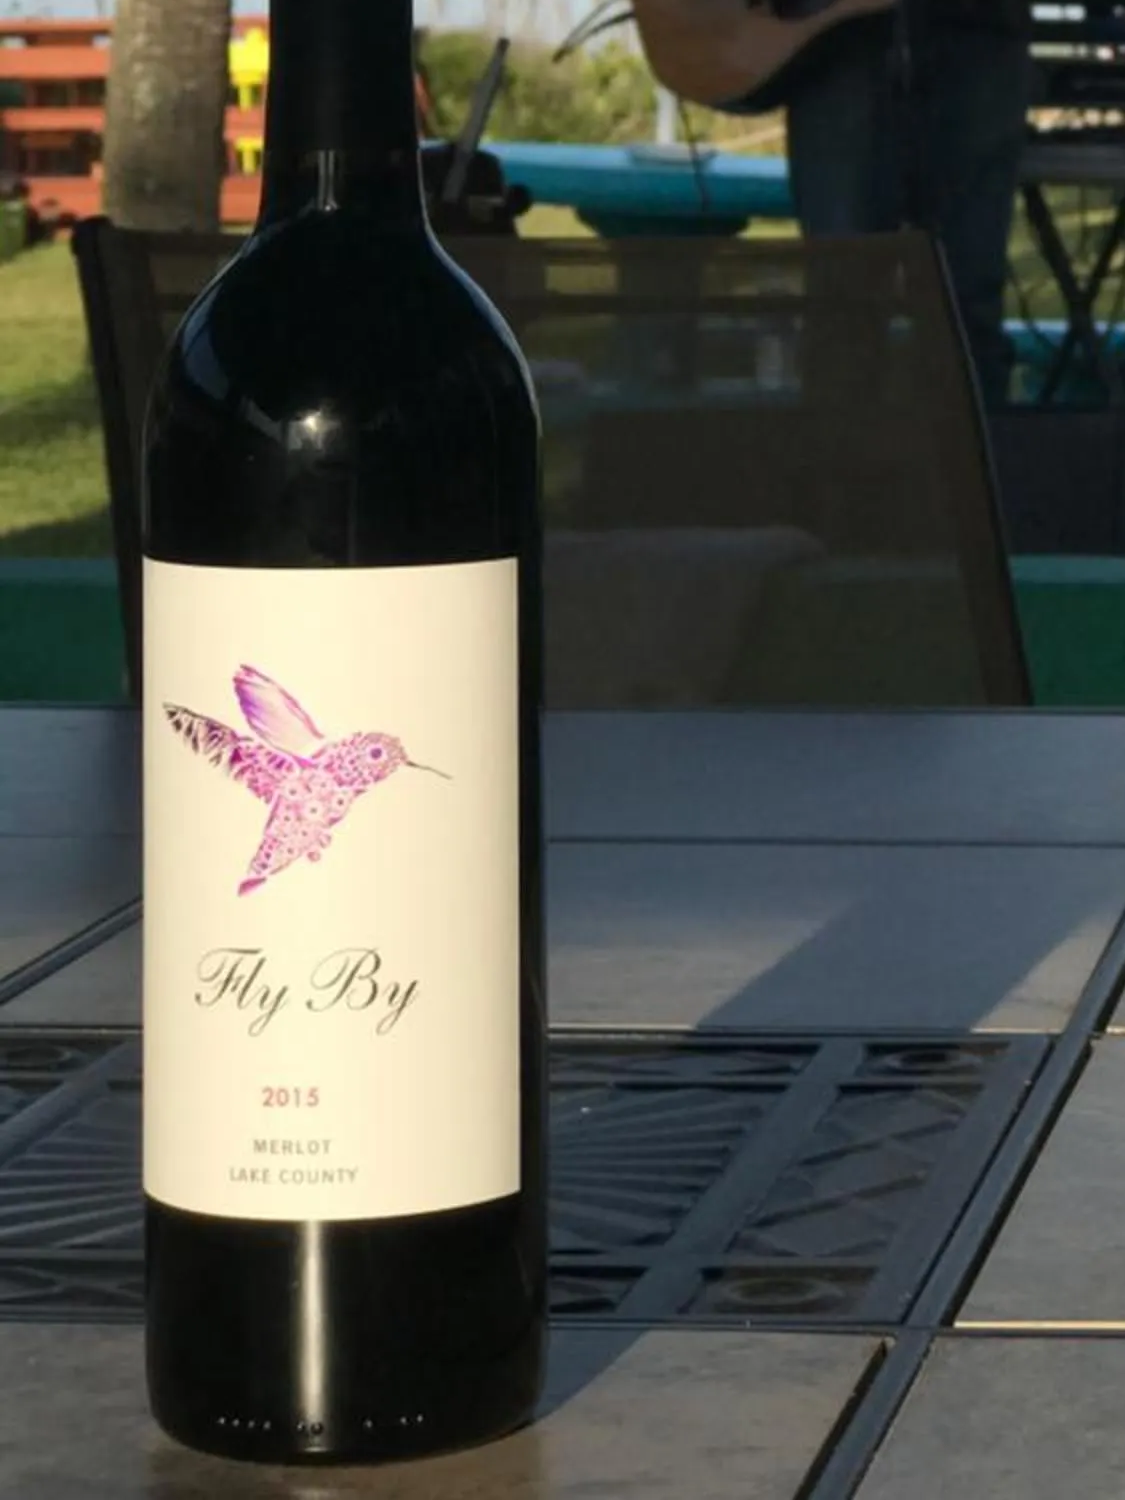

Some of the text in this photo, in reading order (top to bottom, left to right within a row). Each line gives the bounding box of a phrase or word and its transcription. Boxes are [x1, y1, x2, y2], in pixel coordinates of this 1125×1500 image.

[194, 947, 419, 1037] Fly By
[261, 1086, 320, 1108] 2015
[252, 1139, 332, 1155] MERLOT
[229, 1166, 358, 1185] LAKE COUNTY
